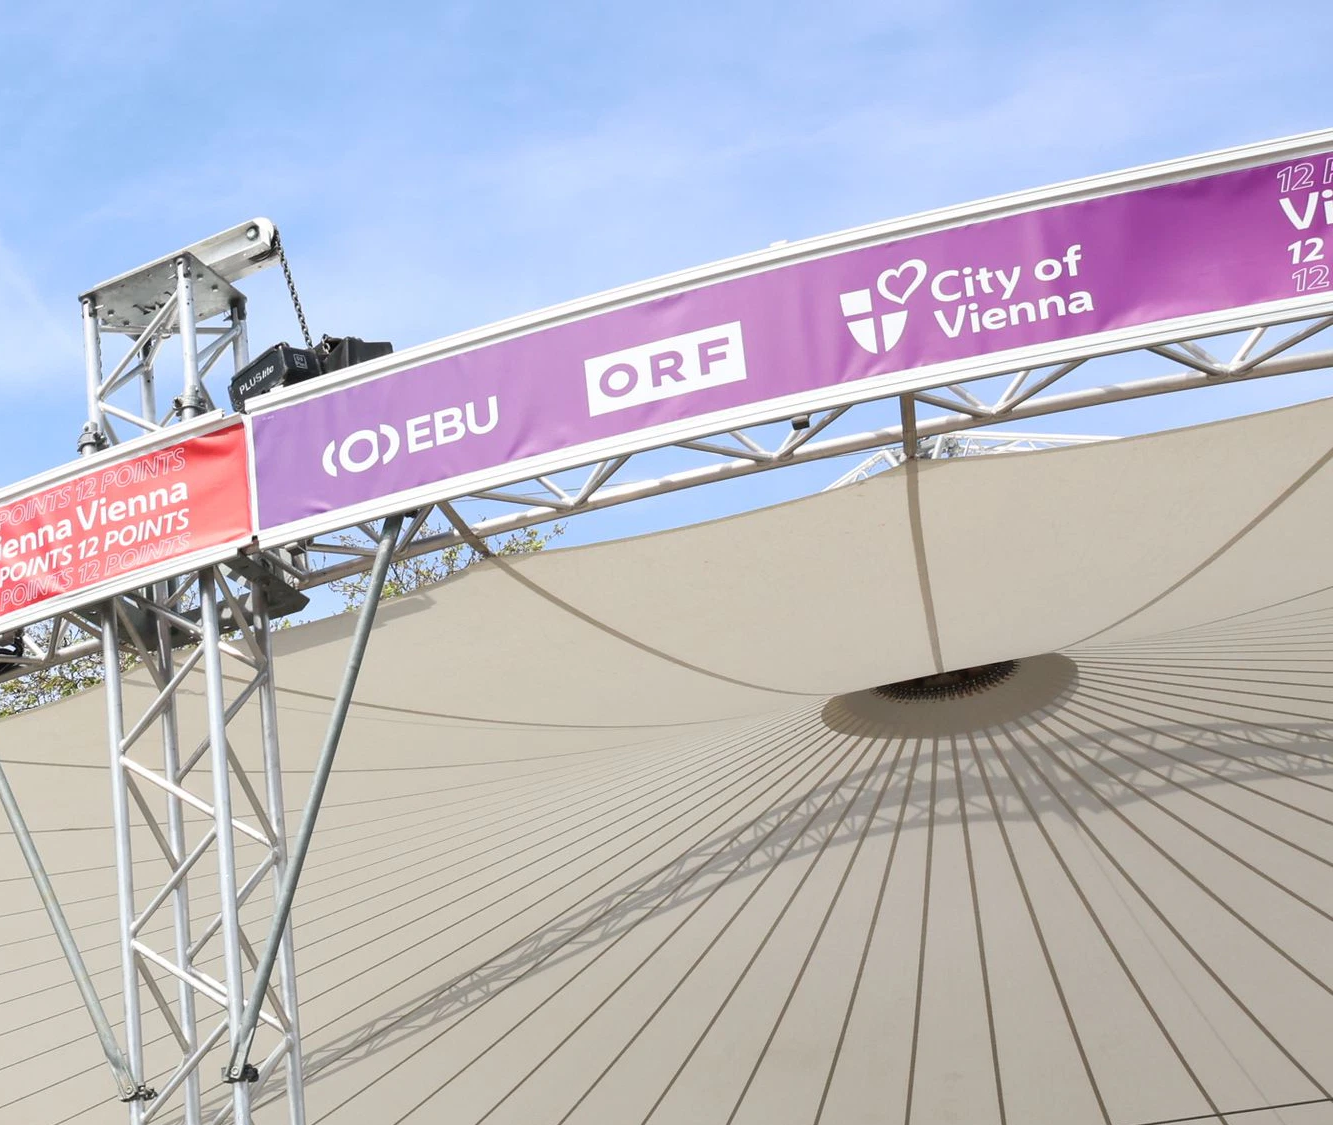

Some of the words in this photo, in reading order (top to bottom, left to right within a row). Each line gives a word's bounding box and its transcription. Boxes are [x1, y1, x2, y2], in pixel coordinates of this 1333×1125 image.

[1276, 162, 1314, 193] 12
[931, 264, 1021, 302] City
[1033, 244, 1082, 283] of
[1287, 237, 1324, 265] 12
[1292, 264, 1330, 292] 12
[934, 289, 1094, 339] Vienna
[599, 337, 730, 398] ORF
[406, 396, 499, 454] EBU
[76, 477, 97, 501] 12
[100, 447, 186, 493] POINTS
[75, 481, 188, 531] Vienna
[77, 536, 100, 560] 12
[103, 508, 190, 552] POINTS
[0, 567, 73, 612] POINTS
[77, 559, 101, 584] 12
[104, 531, 191, 576] POINTS
